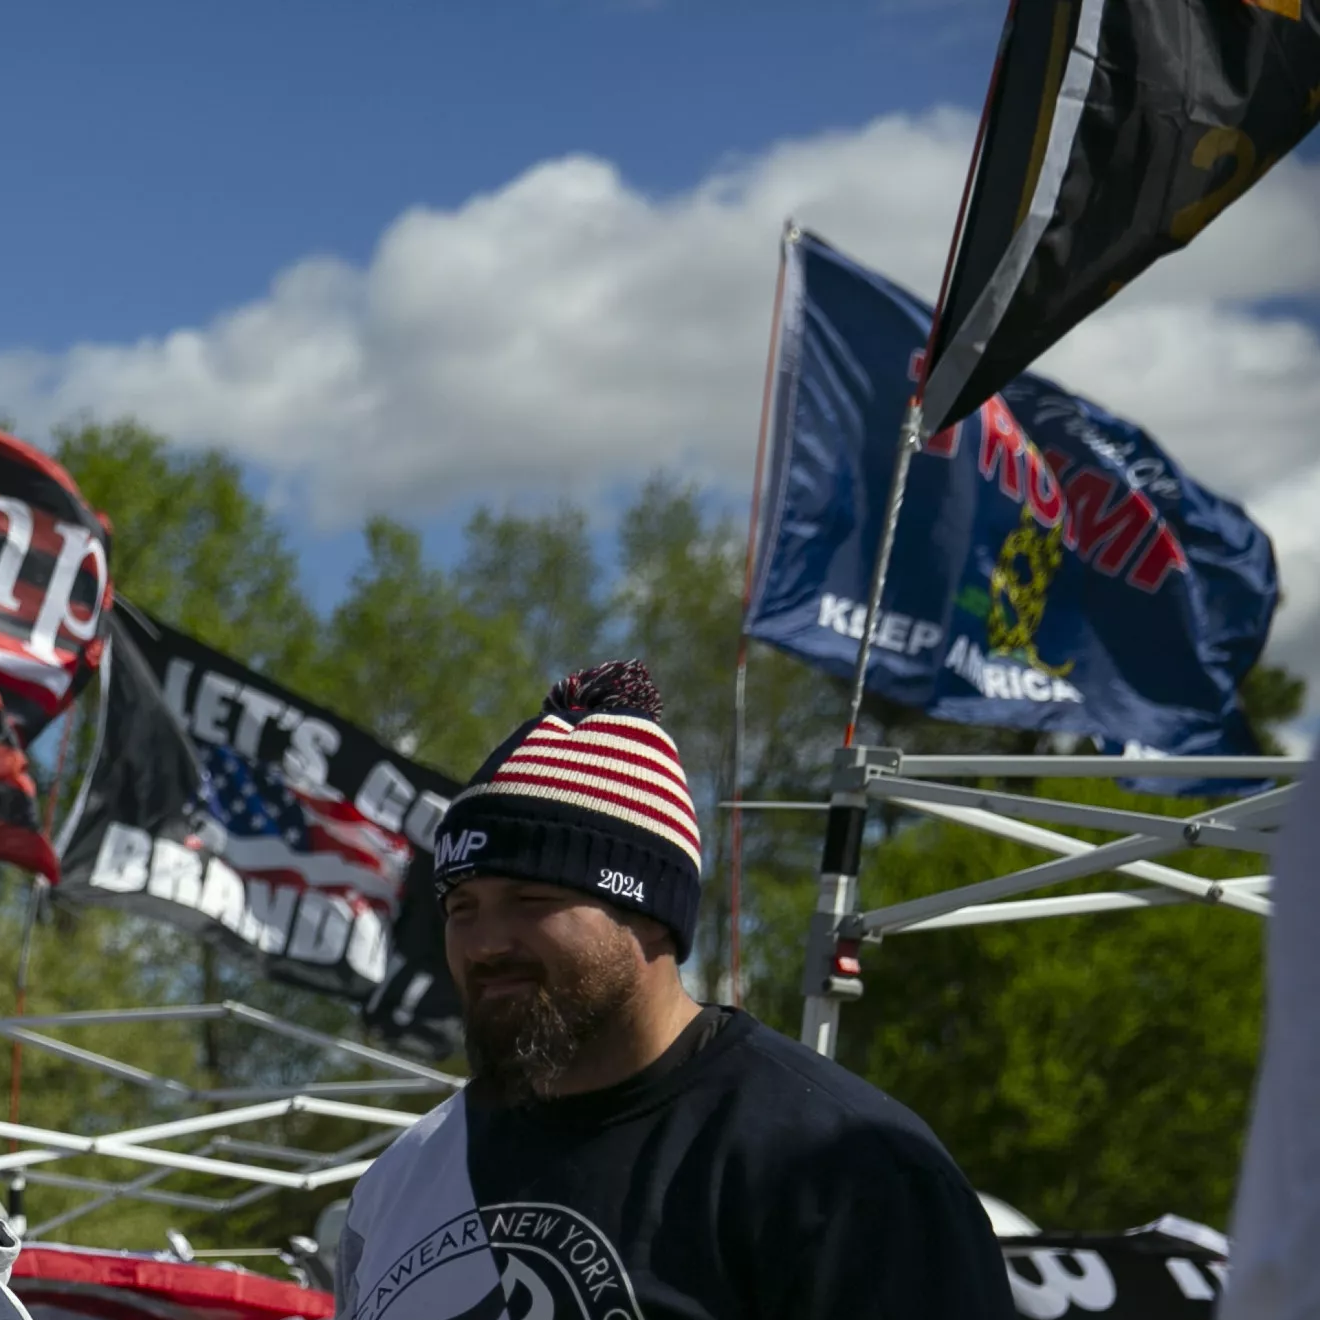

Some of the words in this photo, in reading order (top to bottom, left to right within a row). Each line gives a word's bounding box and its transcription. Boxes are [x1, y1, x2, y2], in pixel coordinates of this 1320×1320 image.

[162, 657, 343, 800] LET'S
[597, 868, 644, 903] 2024
[490, 1211, 560, 1239] NEW
[555, 1223, 619, 1303] YORK
